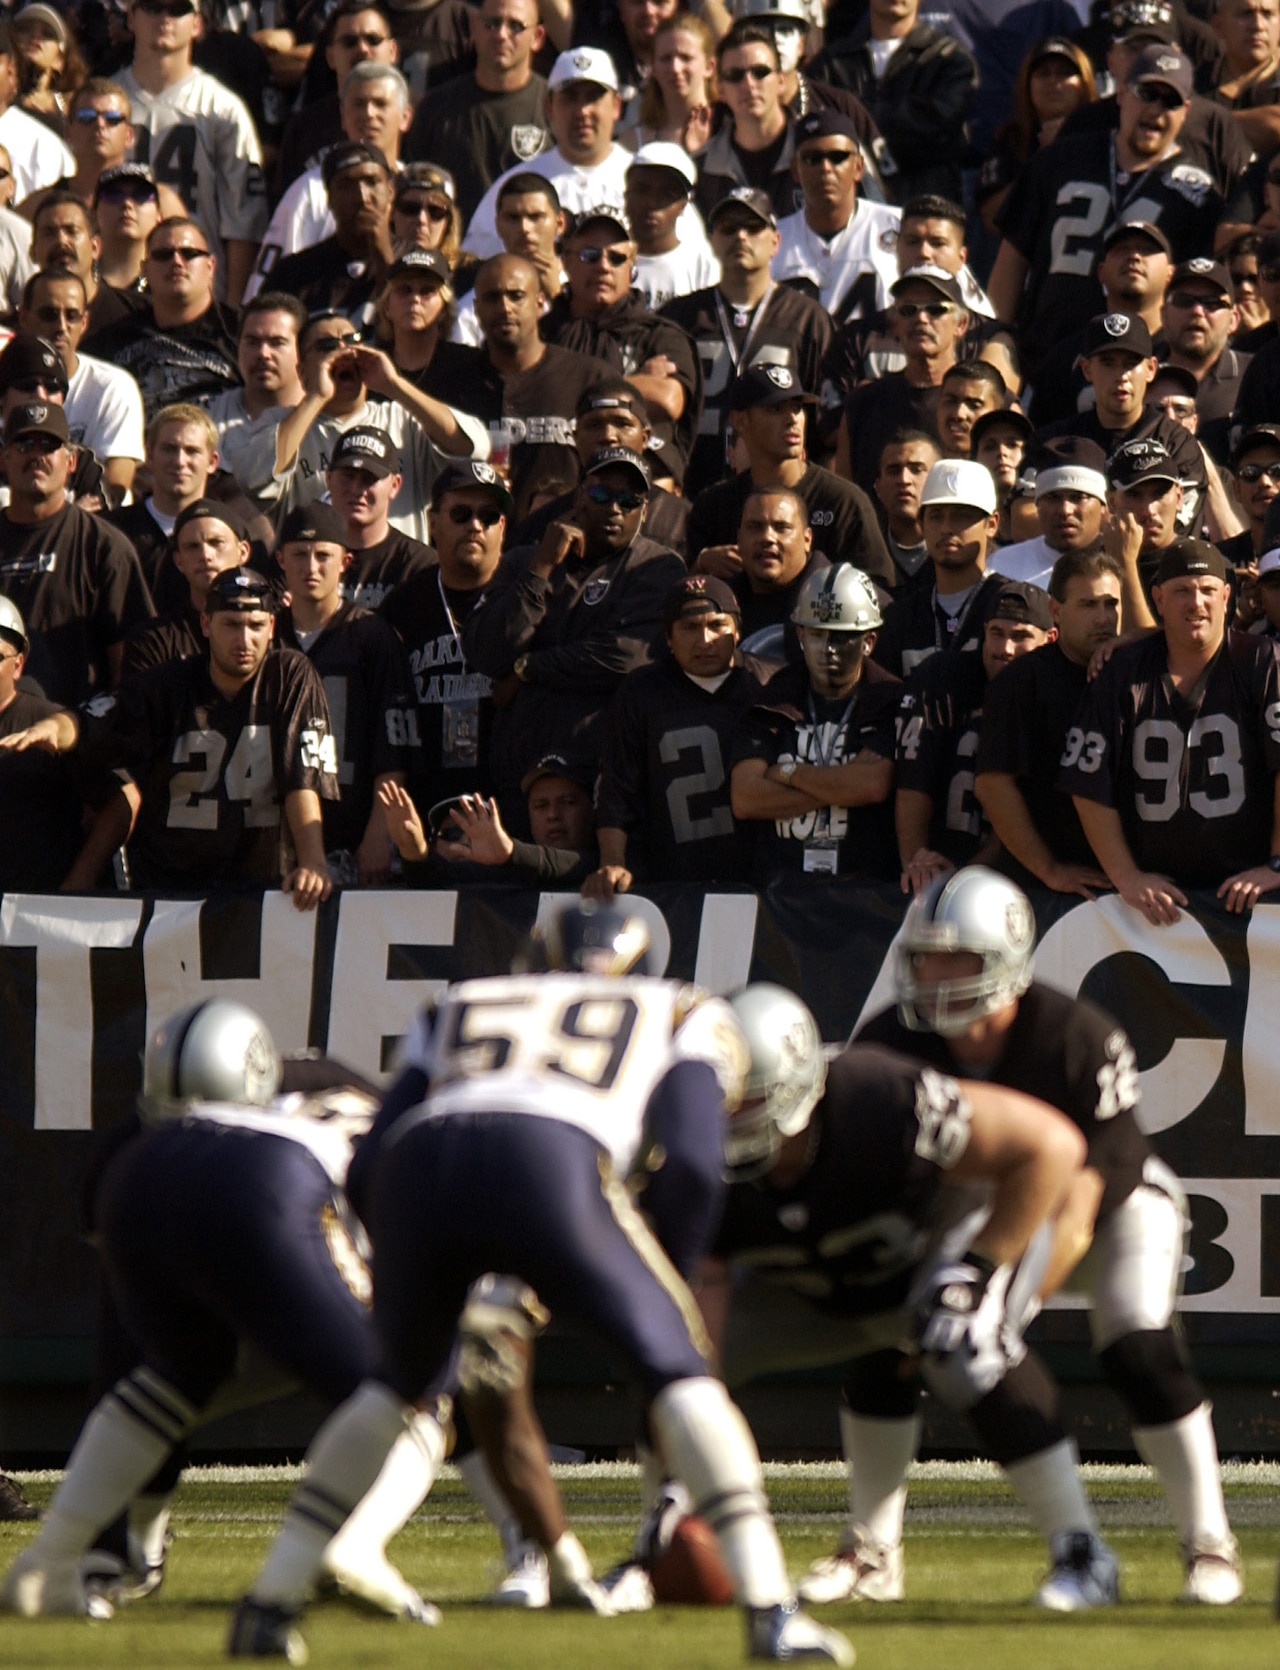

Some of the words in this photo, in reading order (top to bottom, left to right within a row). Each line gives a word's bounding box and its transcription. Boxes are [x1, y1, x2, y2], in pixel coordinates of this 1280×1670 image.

[341, 433, 386, 458] RAIDERS
[299, 730, 339, 774] 24
[384, 708, 422, 747] 81
[1060, 726, 1107, 774] 93
[165, 724, 281, 831] 24
[1131, 712, 1247, 823] 93
[2, 889, 459, 1131] THE
[452, 997, 638, 1091] 59
